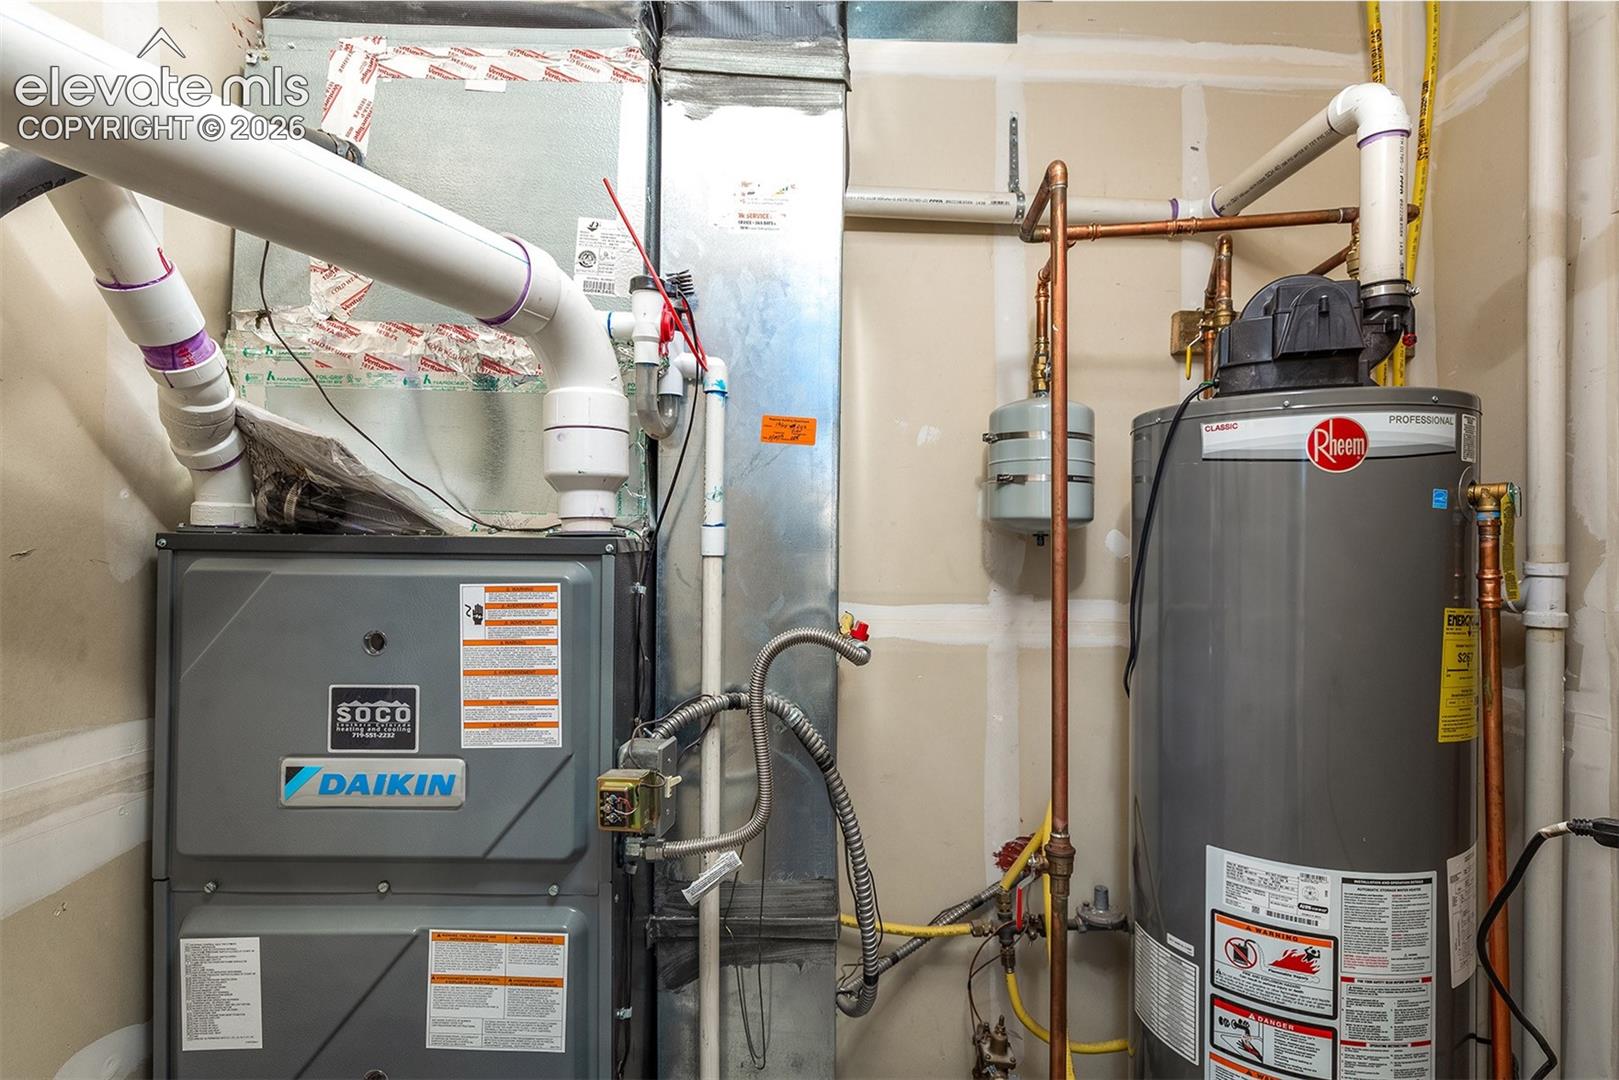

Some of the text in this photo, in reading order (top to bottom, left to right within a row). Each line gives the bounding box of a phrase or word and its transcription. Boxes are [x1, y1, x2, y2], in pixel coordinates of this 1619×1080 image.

[1204, 414, 1455, 433] CLASSIC PROFESSIONAL
[1314, 419, 1366, 464] Rheem
[337, 707, 411, 723] SOCO
[318, 774, 456, 796] DAIKIN
[1254, 928, 1299, 943] WARNING
[1258, 1016, 1295, 1031] DANGER
